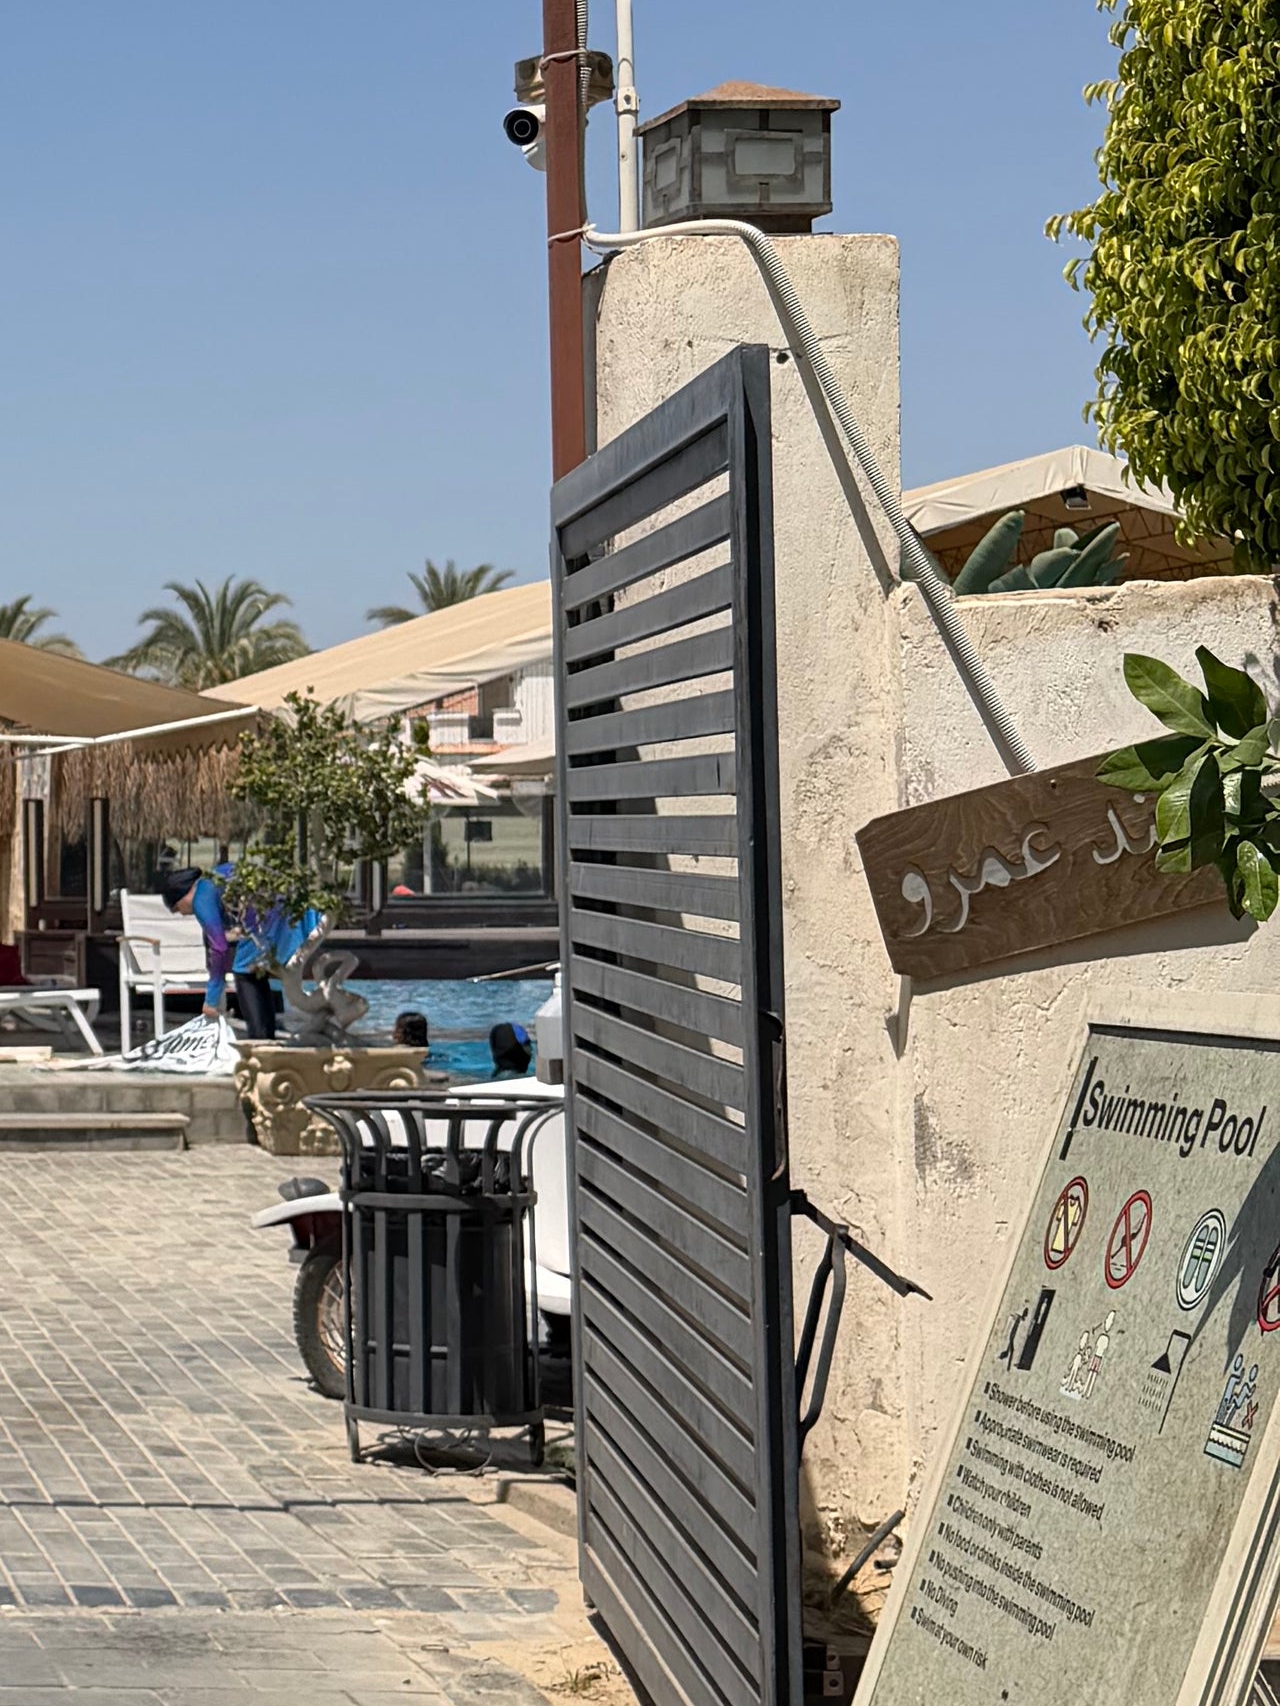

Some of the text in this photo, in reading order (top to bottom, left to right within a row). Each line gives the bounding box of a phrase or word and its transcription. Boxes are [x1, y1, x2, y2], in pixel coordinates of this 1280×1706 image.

[896, 792, 1160, 938] ند عمرو
[1083, 1080, 1268, 1158] Swimming Pool
[988, 1382, 1019, 1409] Shower
[1015, 1394, 1042, 1421] before
[1039, 1409, 1064, 1435] using
[1073, 1424, 1117, 1459] swimming
[1111, 1442, 1137, 1463] pool
[1021, 1434, 1062, 1463] swimwear
[1066, 1456, 1104, 1484] required
[961, 1466, 1032, 1519] Watch your children
[970, 1439, 1009, 1477] Swimming
[1007, 1460, 1025, 1481] with
[1023, 1467, 1053, 1495] clothes
[1057, 1486, 1074, 1506] not
[1070, 1491, 1106, 1522] allowed
[952, 1495, 1044, 1561] Children only with parents
[934, 1585, 959, 1618] Diving
[941, 1561, 974, 1594] pushing
[971, 1579, 988, 1599] into
[997, 1595, 1038, 1634] swimming
[1033, 1618, 1057, 1642] pool
[977, 1545, 1002, 1572] drinks
[999, 1556, 1024, 1586] inside
[1034, 1581, 1076, 1622] swimming
[1071, 1605, 1096, 1628] pool
[915, 1607, 937, 1634] Swim
[939, 1628, 960, 1650] your
[957, 1639, 975, 1661] own
[972, 1647, 989, 1671] risk
